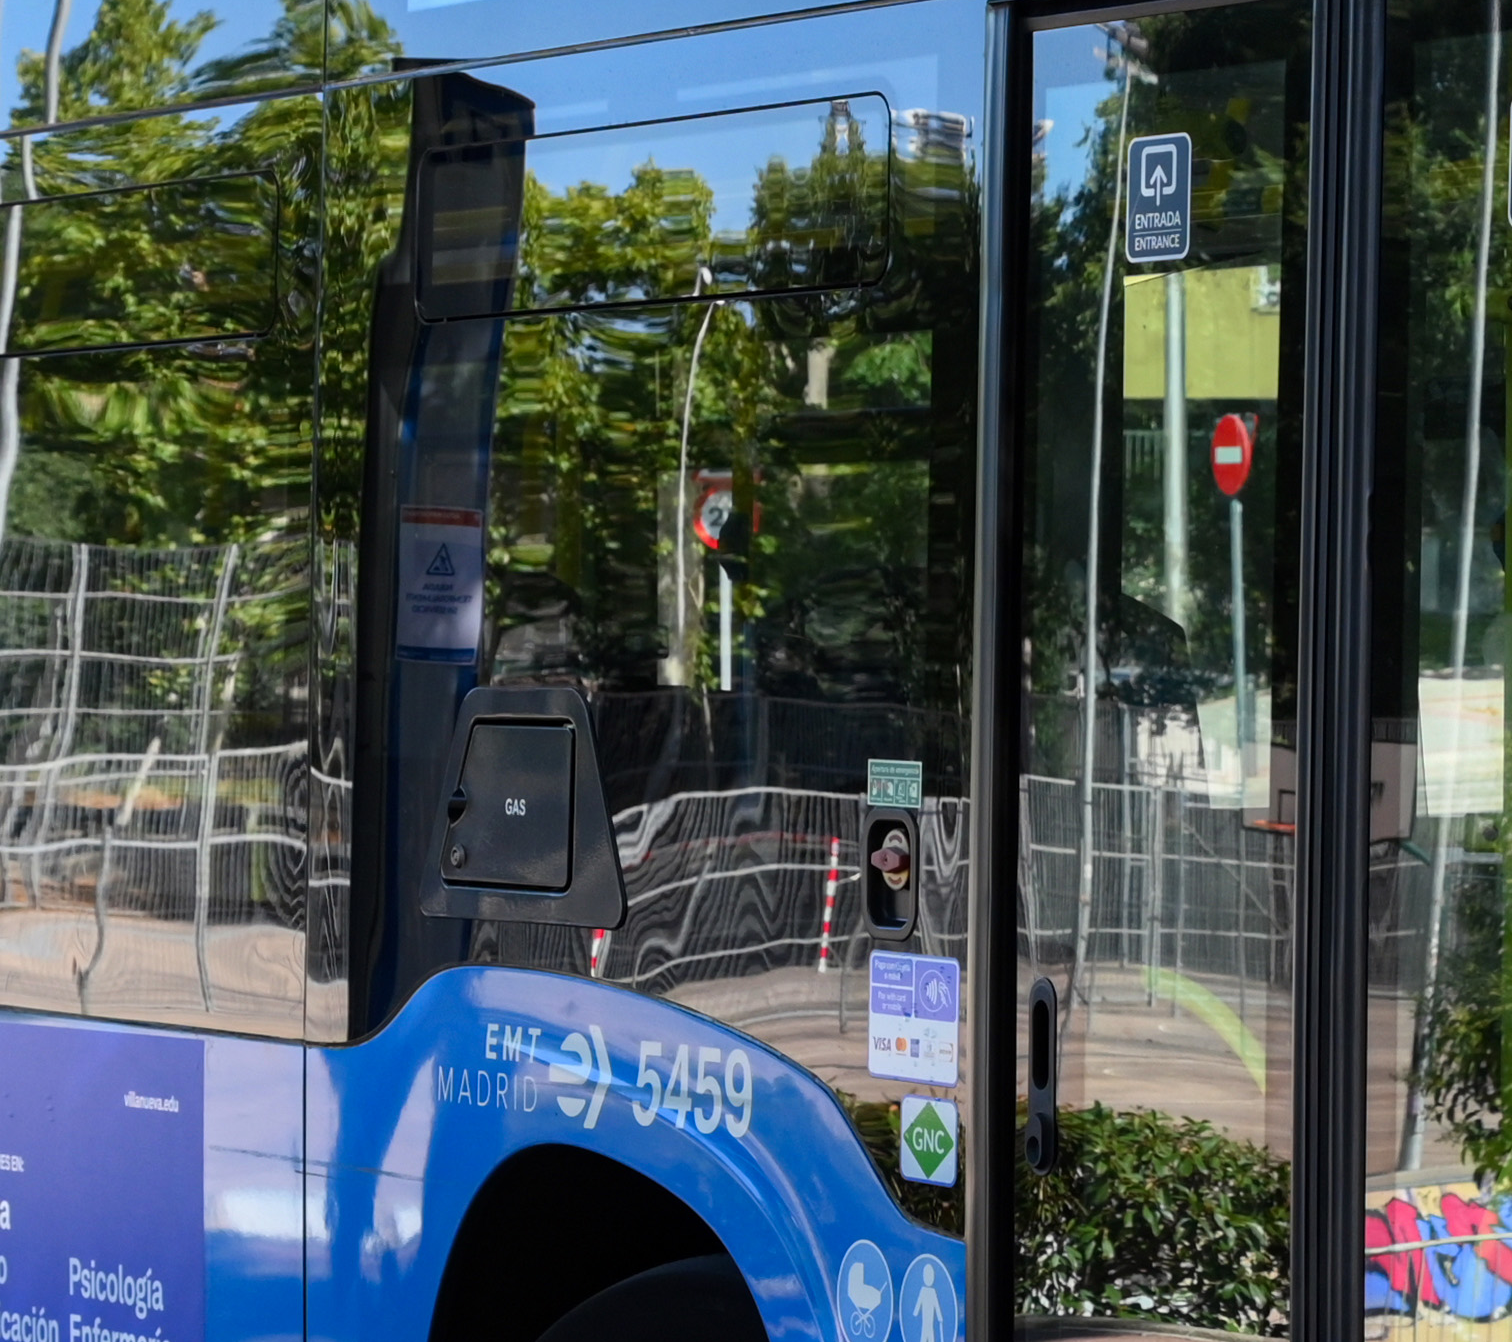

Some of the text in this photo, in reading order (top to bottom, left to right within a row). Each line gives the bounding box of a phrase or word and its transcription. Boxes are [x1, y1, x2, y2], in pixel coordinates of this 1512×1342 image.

[1134, 210, 1182, 230] ENTRADA
[1134, 234, 1181, 251] ENTRANCE
[504, 797, 527, 817] GAS
[484, 1023, 542, 1064] EMT
[872, 1036, 892, 1052] VISA
[123, 1090, 179, 1113] villanueva.edu
[437, 1065, 539, 1113] MADRID
[631, 1040, 753, 1139] 5459
[911, 1125, 946, 1156] GNC
[69, 1257, 165, 1320] Psicología
